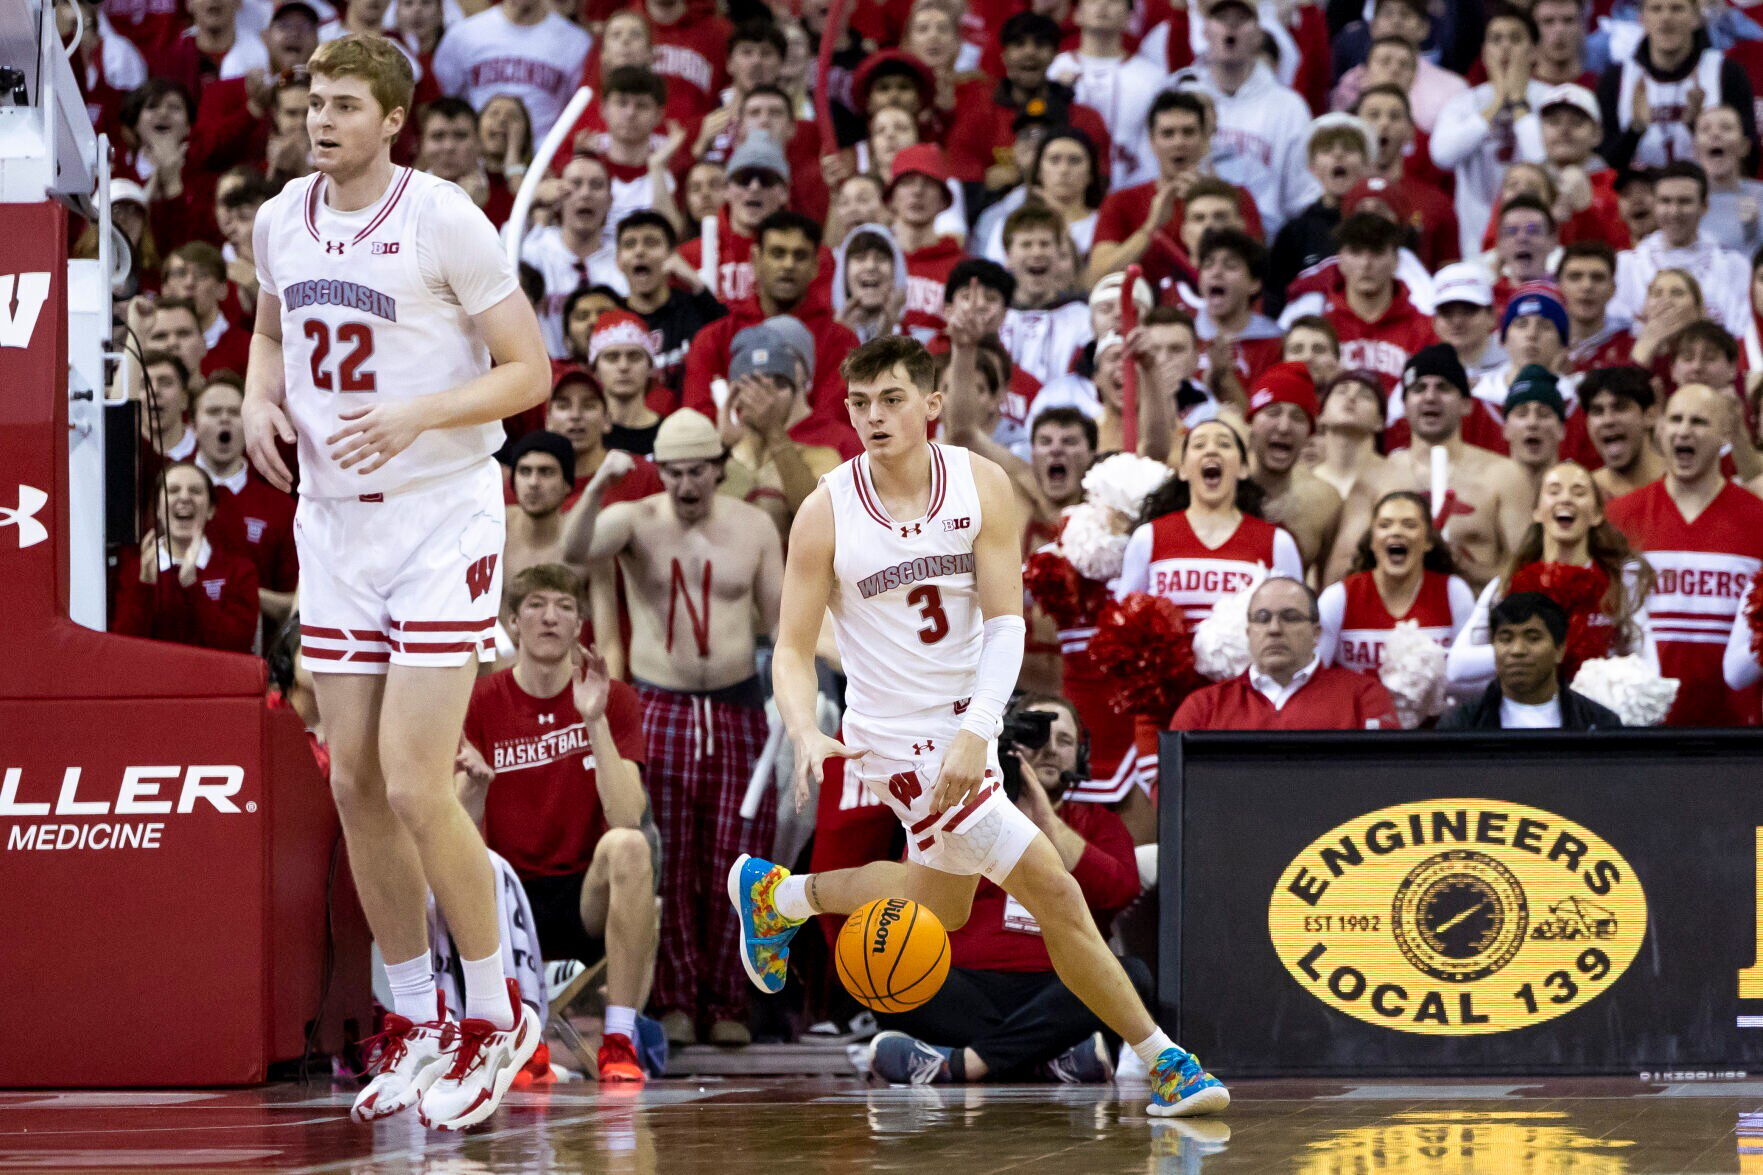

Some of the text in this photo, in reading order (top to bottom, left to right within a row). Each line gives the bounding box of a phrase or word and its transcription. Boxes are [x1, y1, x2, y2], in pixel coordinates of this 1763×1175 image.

[283, 278, 397, 323] WISCONSIN
[303, 317, 378, 394] 22
[465, 553, 498, 604] W
[856, 552, 975, 599] WISCONSIN
[665, 557, 712, 659] N
[905, 584, 950, 646] 3
[0, 765, 245, 816] LLER
[7, 822, 165, 851] MEDICINE
[1288, 810, 1620, 906] ENGINEERS
[872, 898, 909, 954] Wilson
[1305, 915, 1381, 932] EST 1902
[1296, 942, 1611, 1025] LOCAL 139
